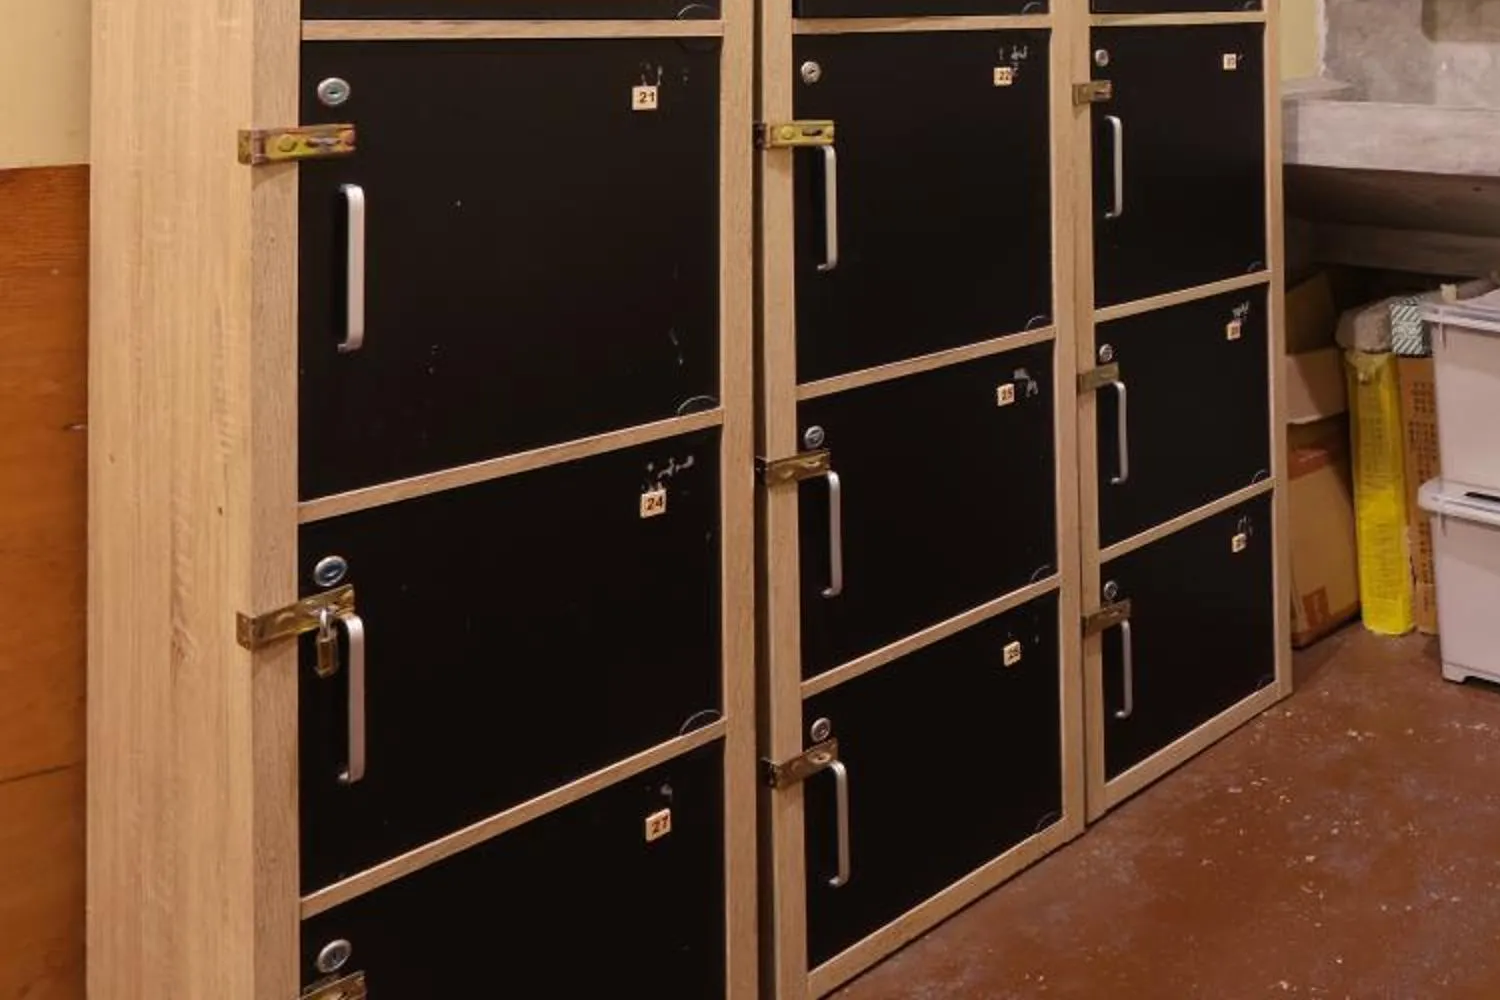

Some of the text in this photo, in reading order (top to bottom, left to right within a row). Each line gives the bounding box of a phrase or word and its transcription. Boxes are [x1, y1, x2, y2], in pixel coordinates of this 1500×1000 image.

[639, 91, 655, 104] 21
[646, 495, 663, 511] 24
[651, 814, 669, 834] 27
